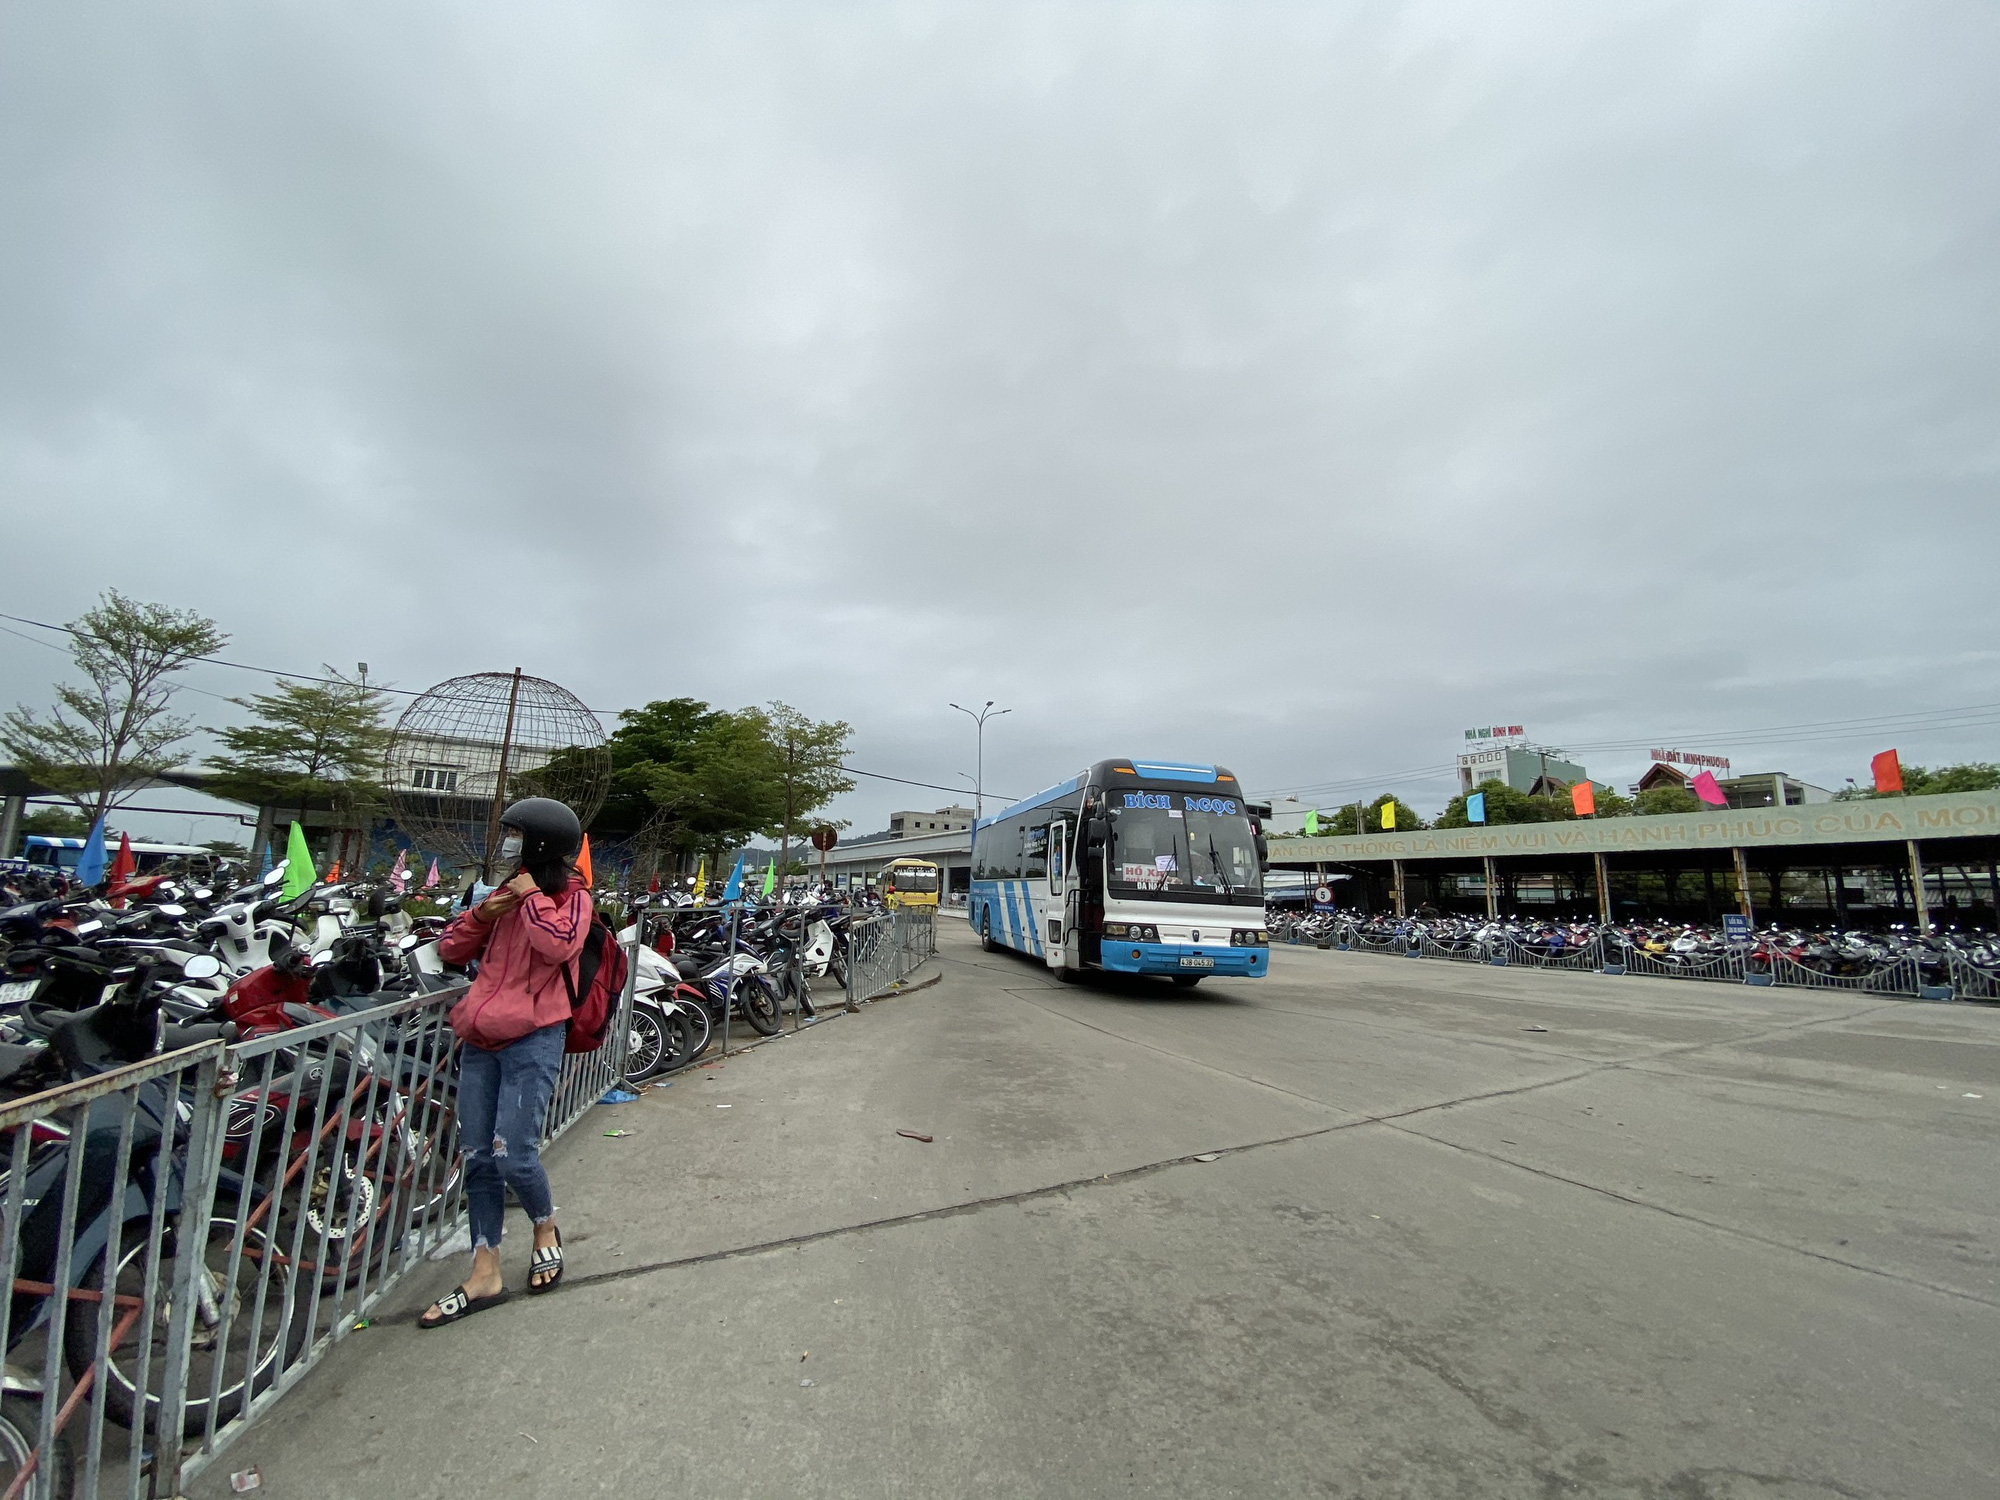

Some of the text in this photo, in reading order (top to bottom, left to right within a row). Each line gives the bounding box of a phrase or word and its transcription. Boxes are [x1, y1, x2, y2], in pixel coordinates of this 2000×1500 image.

[1508, 725, 1523, 736] MINH
[1123, 790, 1236, 816] BÍCH NGỌC
[1298, 844, 1338, 856] GIAO
[1341, 839, 1406, 855] THÔNG
[1412, 834, 1438, 852] LÀ
[1445, 829, 1498, 851] NIỀM
[1504, 833, 1547, 848] VUI
[1554, 825, 1590, 846] VÀ
[1599, 825, 1687, 849] HẠNH
[1697, 814, 1800, 839] PHÚC
[1813, 805, 1903, 832] CỦA
[1917, 805, 1998, 834] MỌI
[1320, 891, 1326, 900] 5
